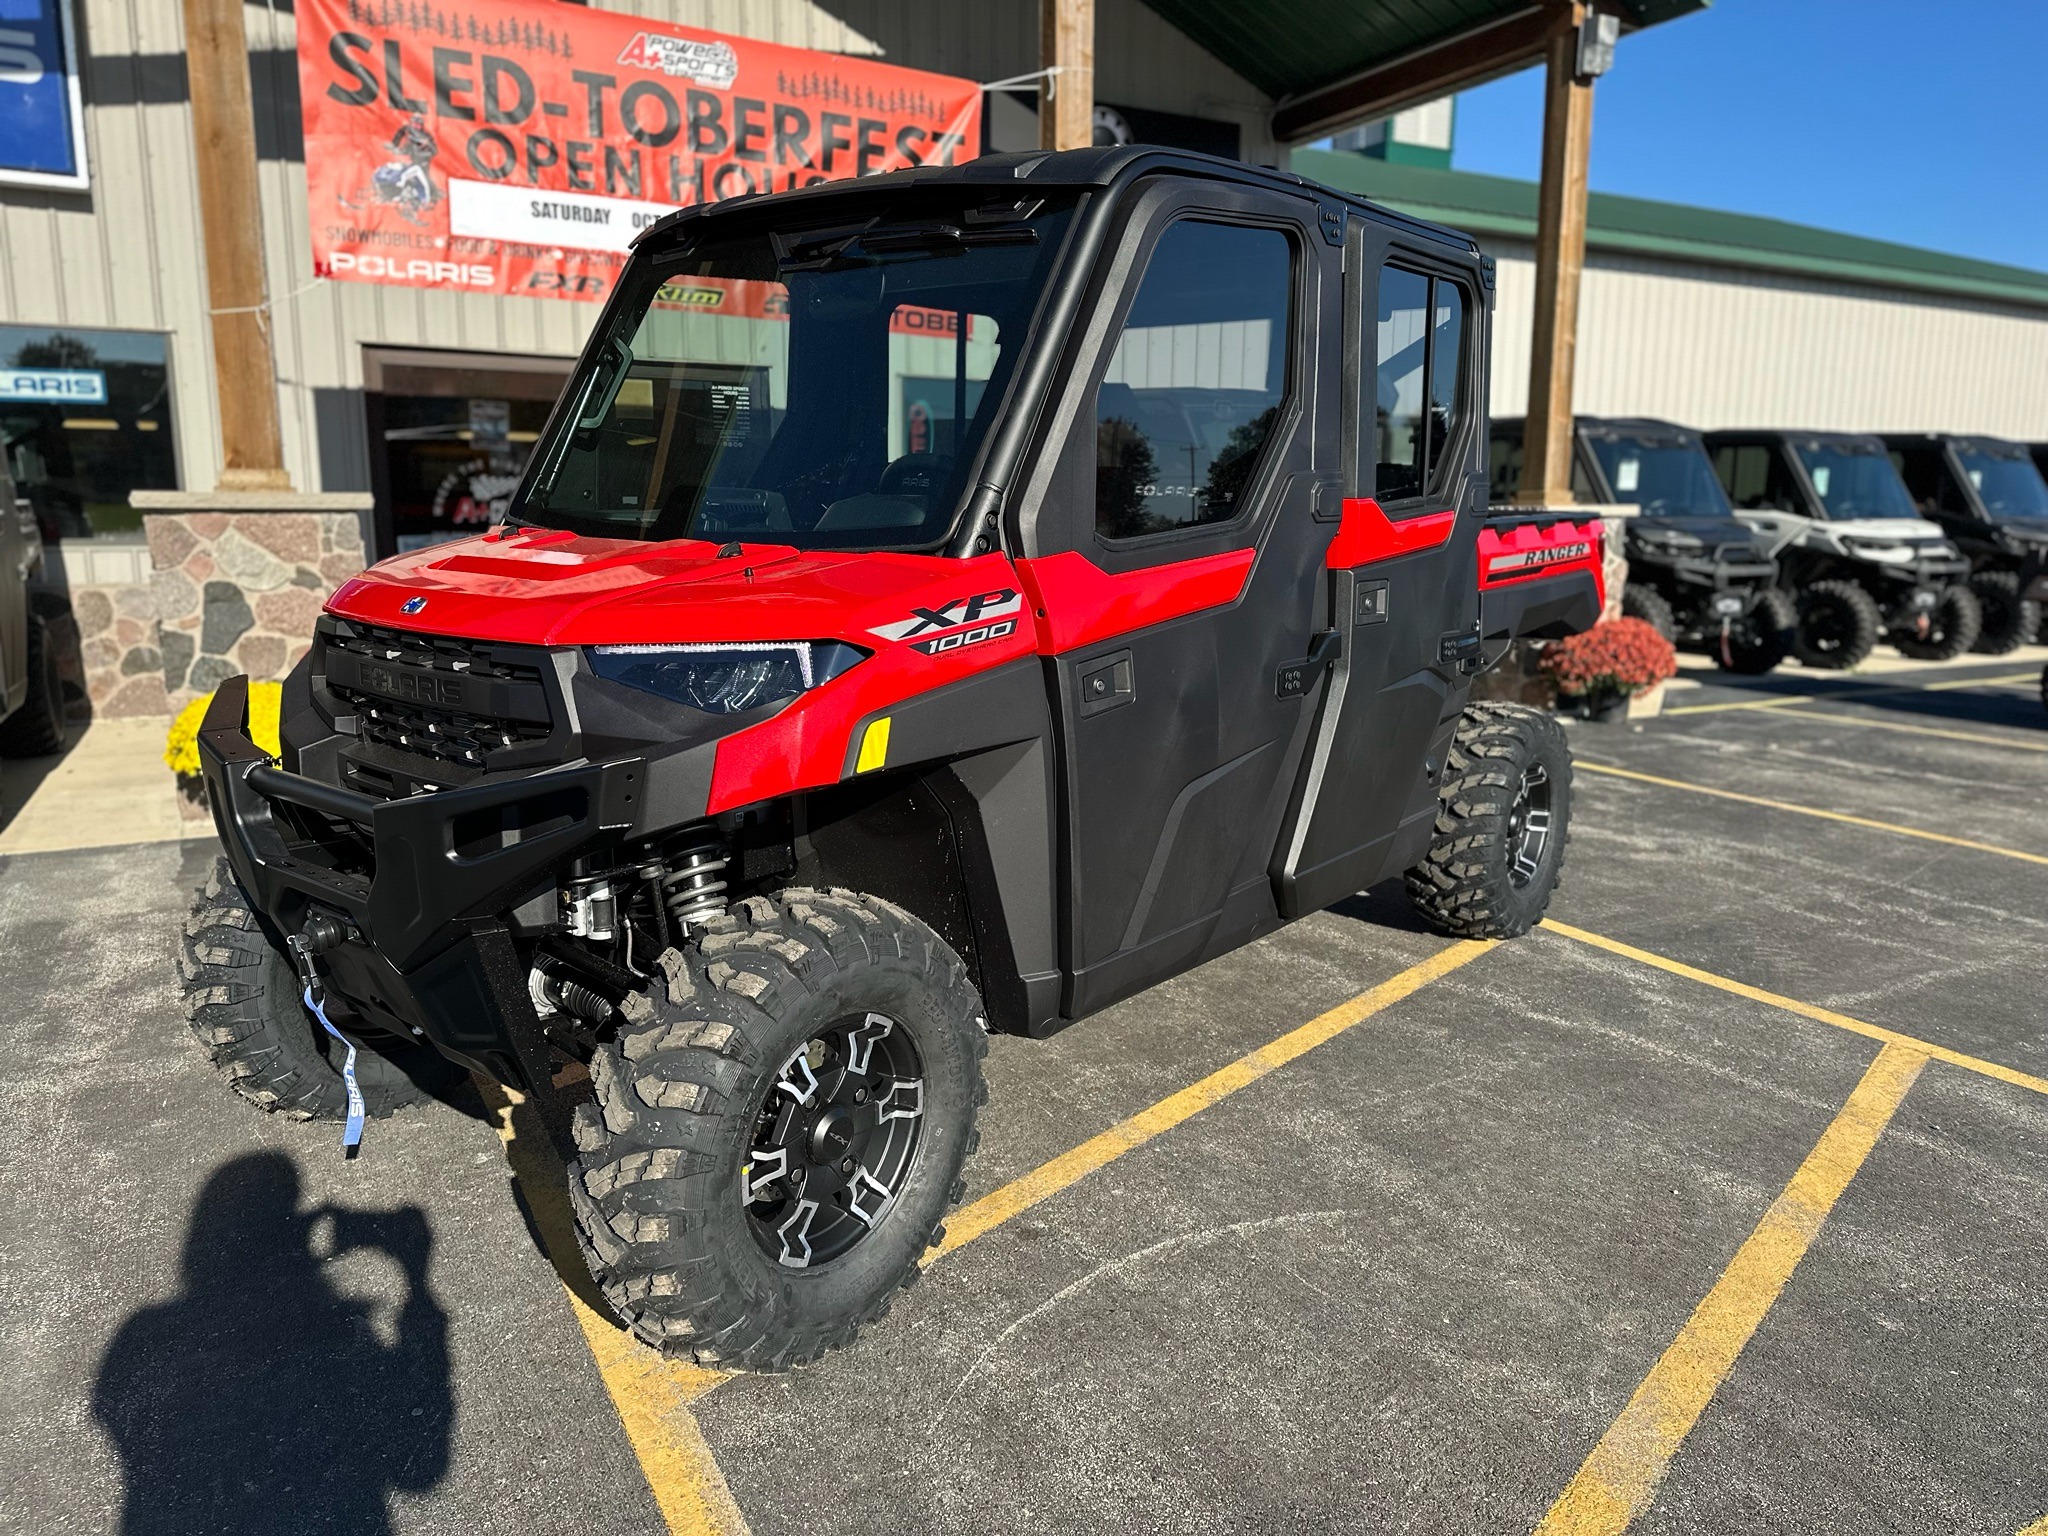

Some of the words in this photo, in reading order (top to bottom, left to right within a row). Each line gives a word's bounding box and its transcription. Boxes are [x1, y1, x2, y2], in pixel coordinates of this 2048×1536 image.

[326, 31, 965, 176] SLED-TOBERFEST
[466, 128, 641, 197] OPEN
[530, 200, 612, 226] SATURDAY
[325, 224, 434, 250] SNOWMOBILES
[329, 251, 495, 286] POLARIS
[528, 270, 605, 294] FXR
[1134, 485, 1200, 498] POLARIS
[1524, 542, 1586, 567] RANGER
[896, 587, 1018, 640] XP
[928, 621, 1013, 655] 1000
[933, 651, 955, 662] DUAL
[955, 640, 997, 657] OVERHEAD
[359, 661, 463, 707] POLARIS
